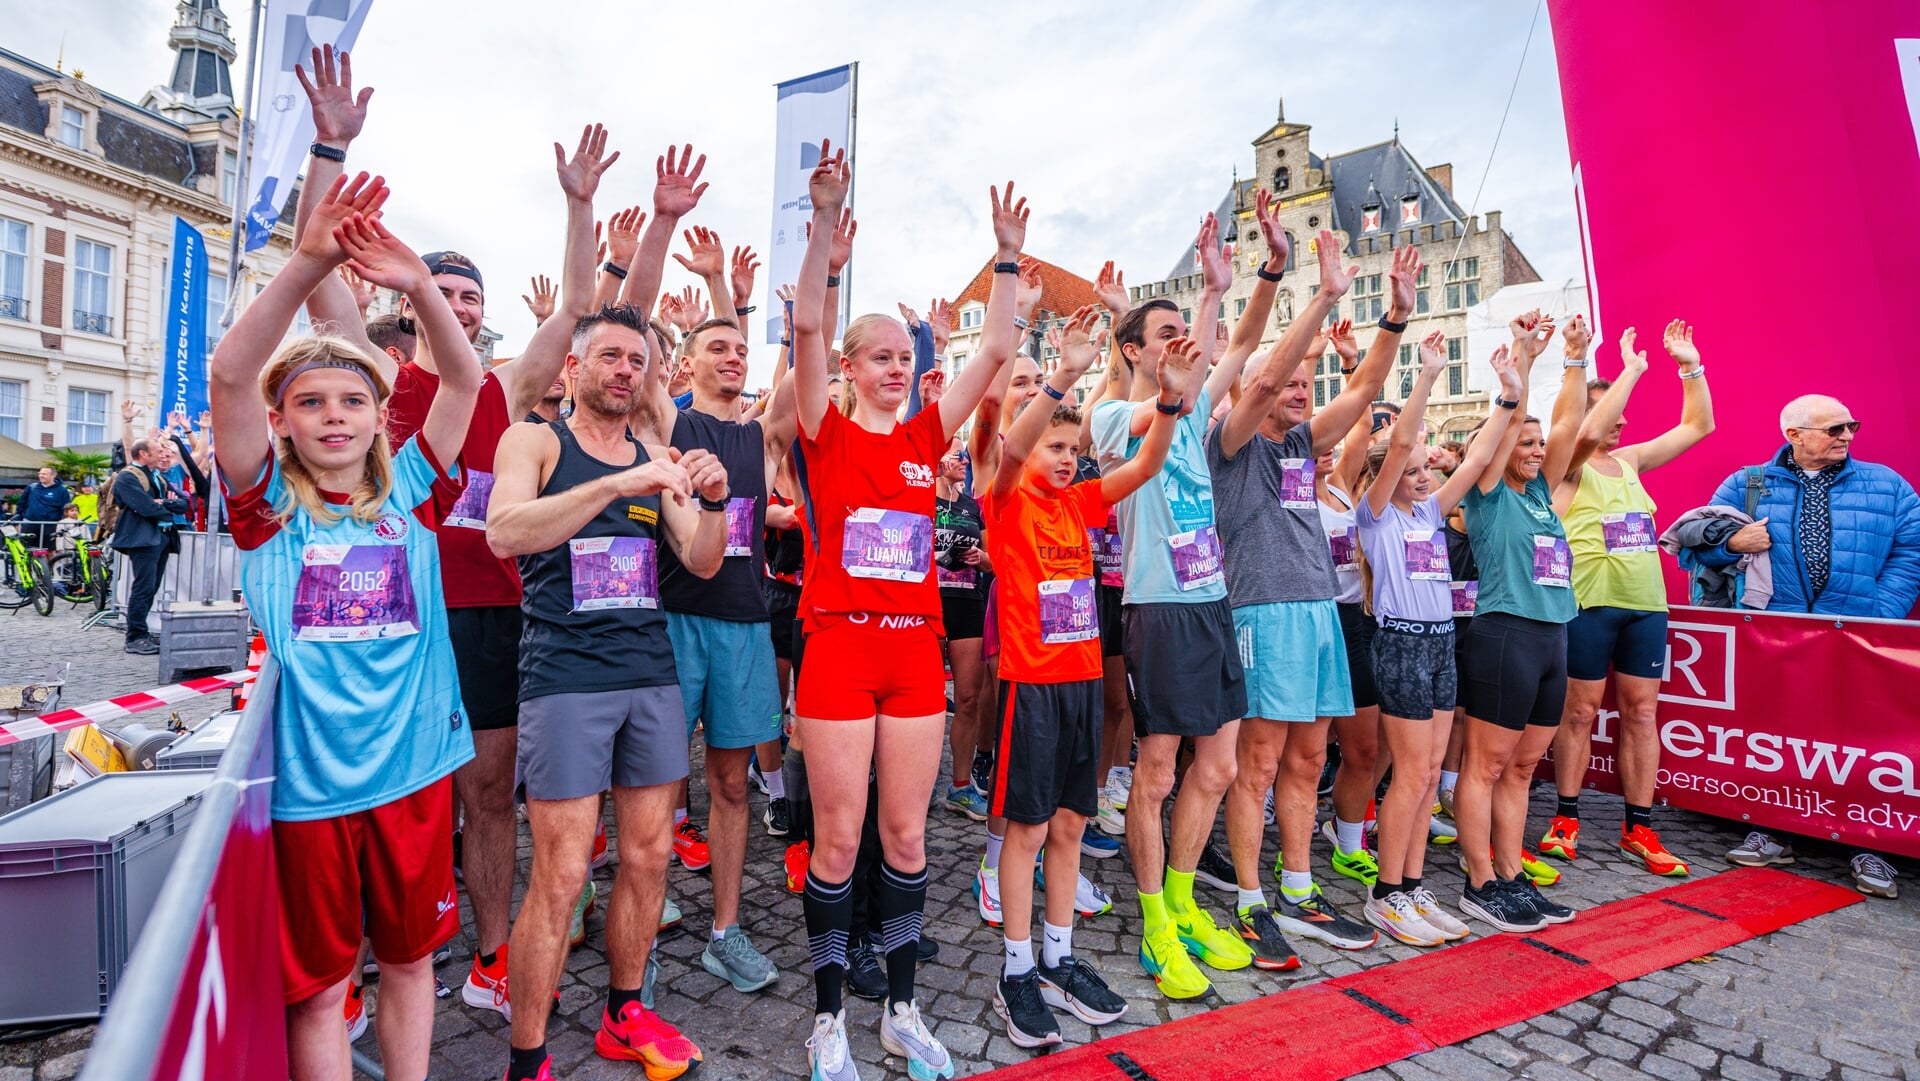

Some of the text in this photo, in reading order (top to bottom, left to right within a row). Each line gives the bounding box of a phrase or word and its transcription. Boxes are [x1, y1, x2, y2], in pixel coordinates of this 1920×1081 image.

[174, 235, 194, 416] Bruynzeel Keukens
[883, 528, 902, 544] 961
[610, 555, 637, 572] 2106
[866, 545, 913, 565] LUANNA
[339, 570, 386, 592] 2052
[1072, 595, 1089, 610] 845
[879, 614, 925, 629] NIKE
[1385, 619, 1456, 635] PRO NIKE
[1654, 767, 1836, 817] persoonlijk
